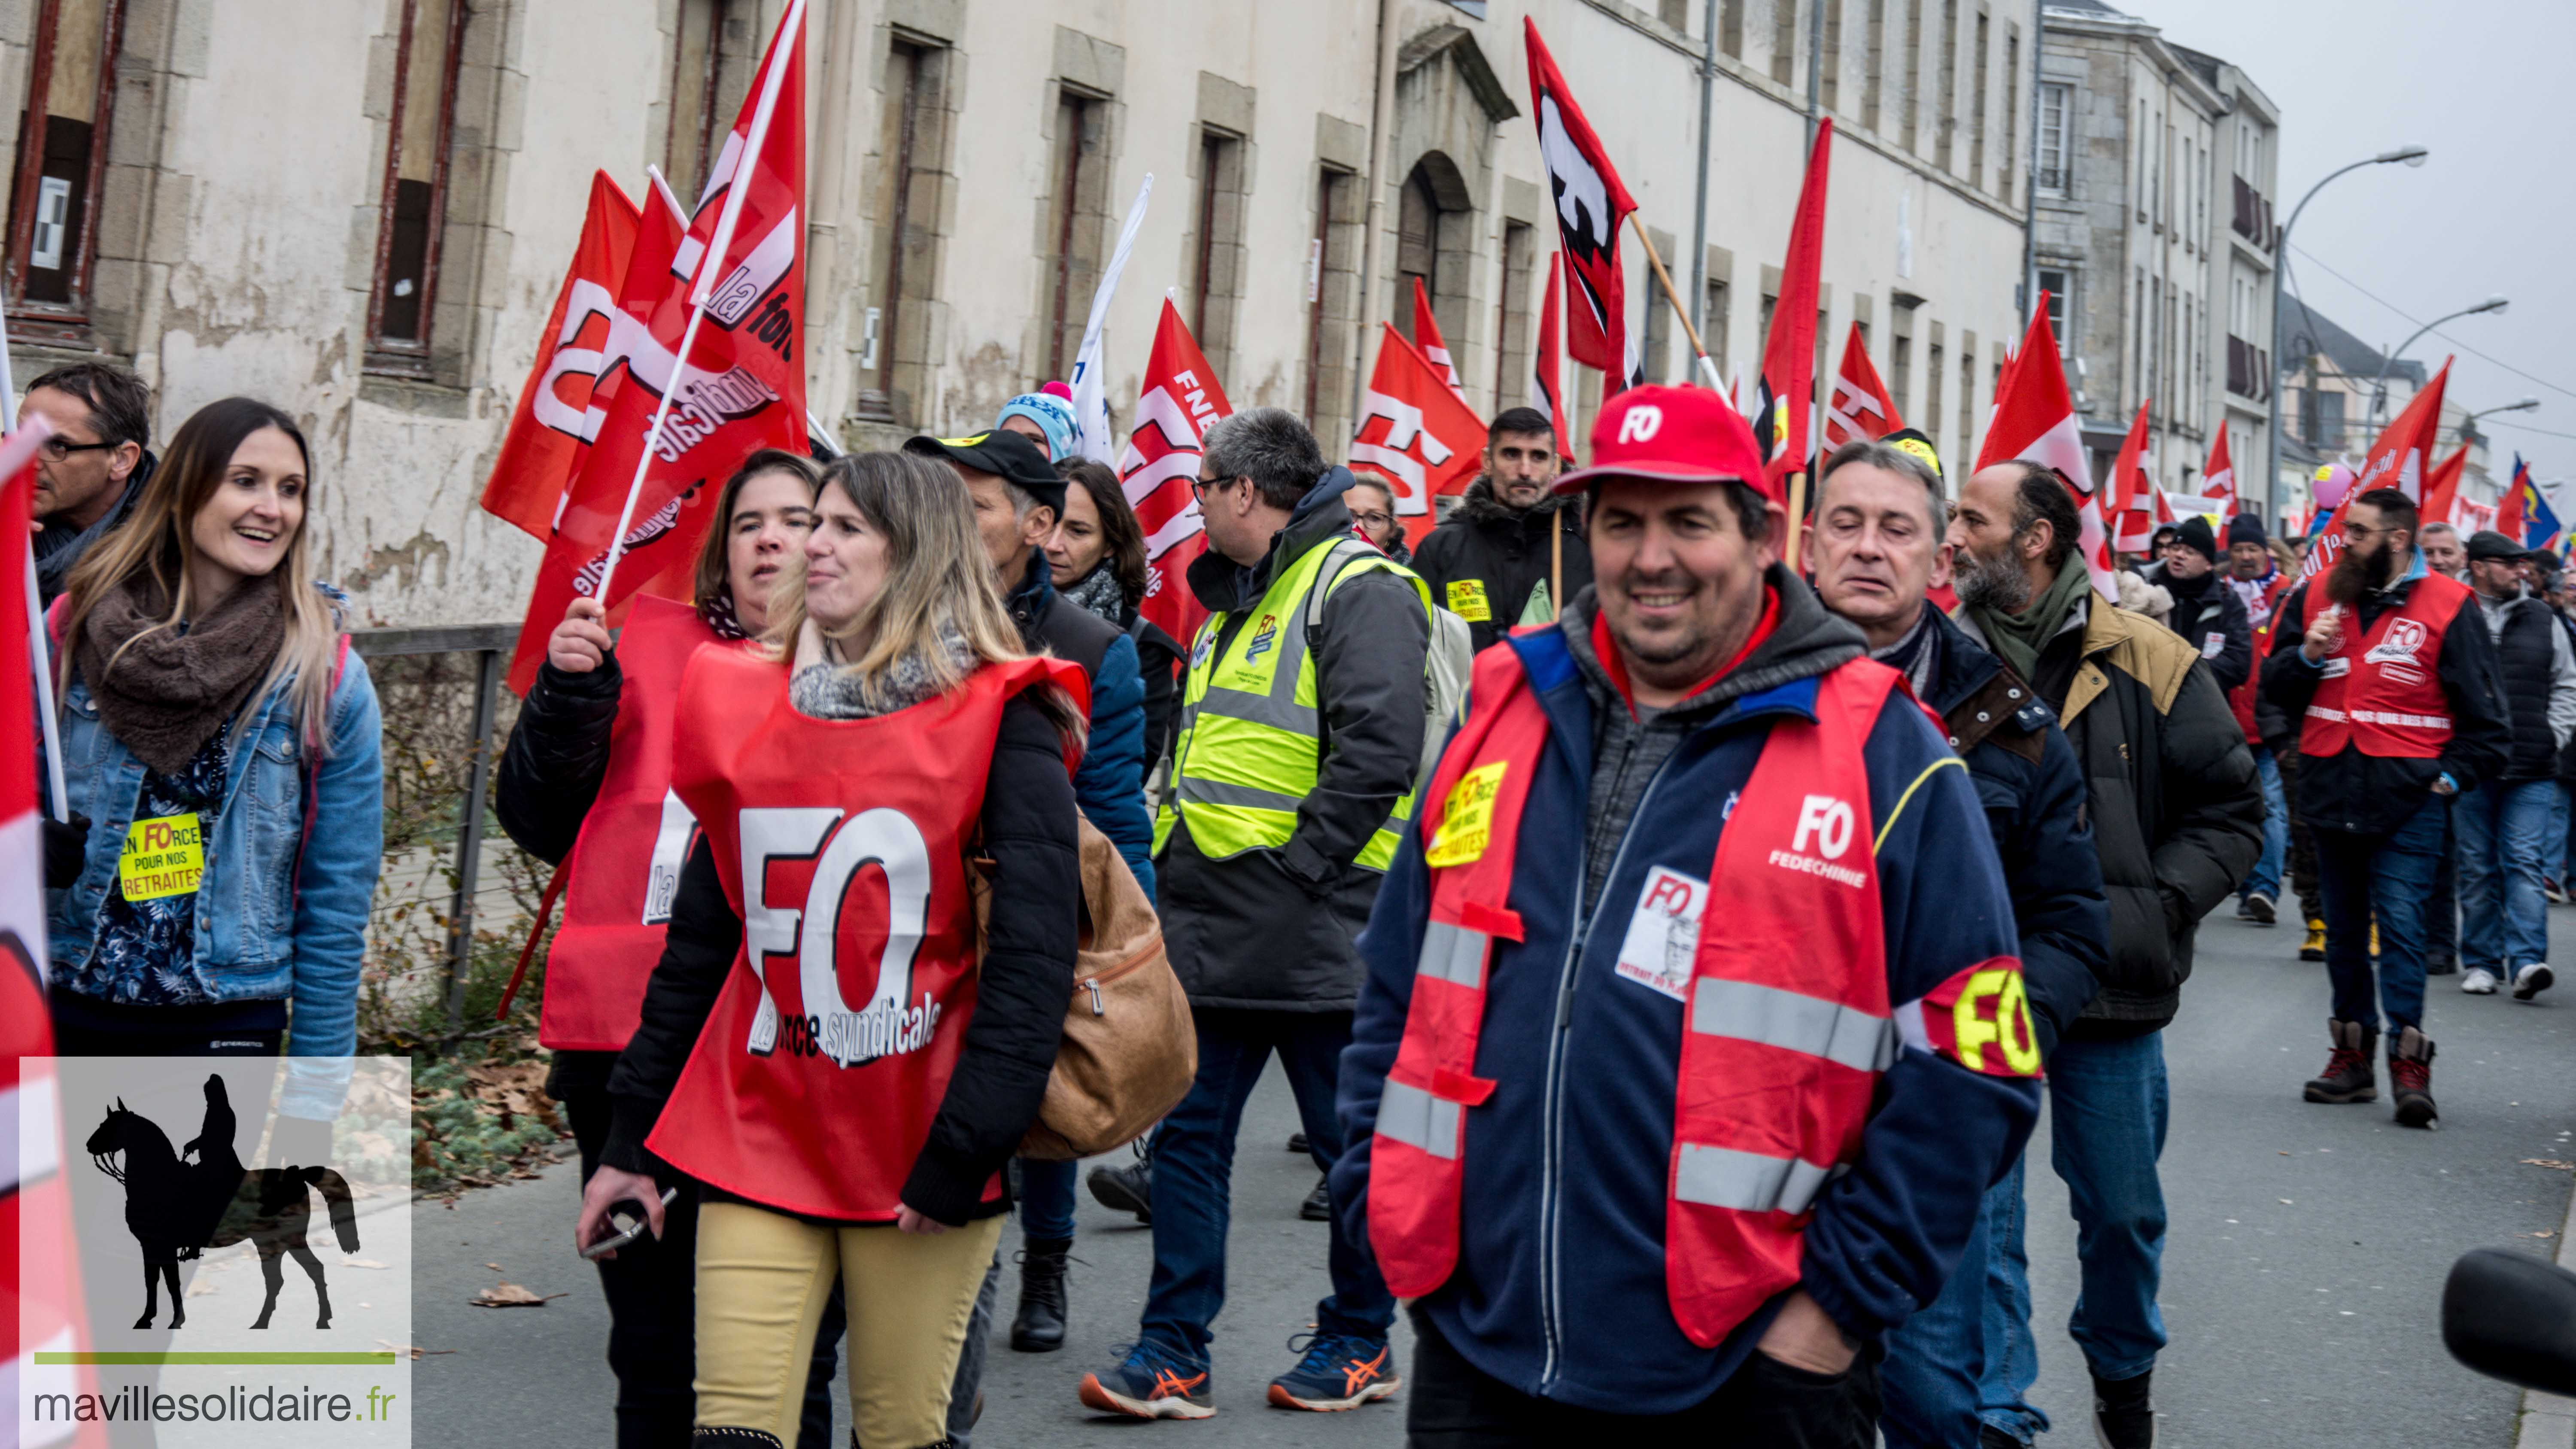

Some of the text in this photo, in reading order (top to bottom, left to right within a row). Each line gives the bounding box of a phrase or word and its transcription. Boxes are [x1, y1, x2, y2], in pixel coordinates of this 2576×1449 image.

[707, 265, 757, 321] la
[1618, 404, 1663, 444] FO
[144, 822, 200, 852] FORCE
[1791, 795, 1855, 859] FO
[124, 867, 202, 896] RETRAITES
[134, 851, 187, 872] POUR NOS
[1643, 875, 1692, 917] FO
[739, 807, 931, 1065] FO
[826, 991, 942, 1069] syndicale
[1953, 969, 2043, 1074] FO
